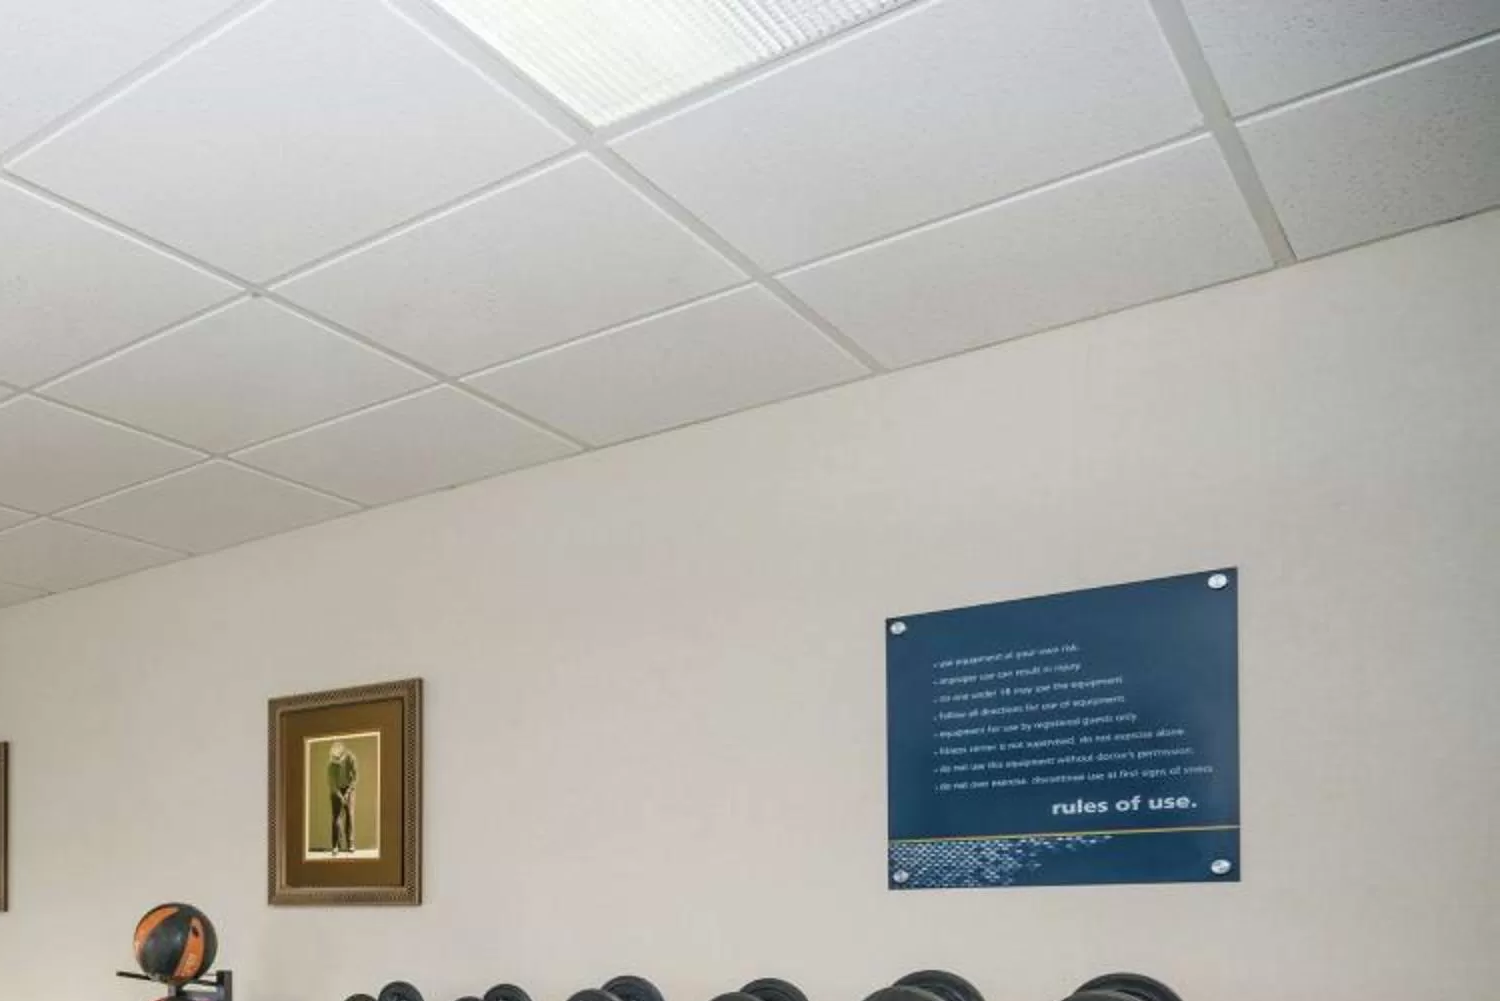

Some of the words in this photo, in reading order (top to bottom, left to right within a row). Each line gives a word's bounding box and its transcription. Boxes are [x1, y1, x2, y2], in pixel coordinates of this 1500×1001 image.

[1051, 798, 1108, 815] rules
[1115, 795, 1141, 811] of
[1148, 796, 1197, 811] use.
